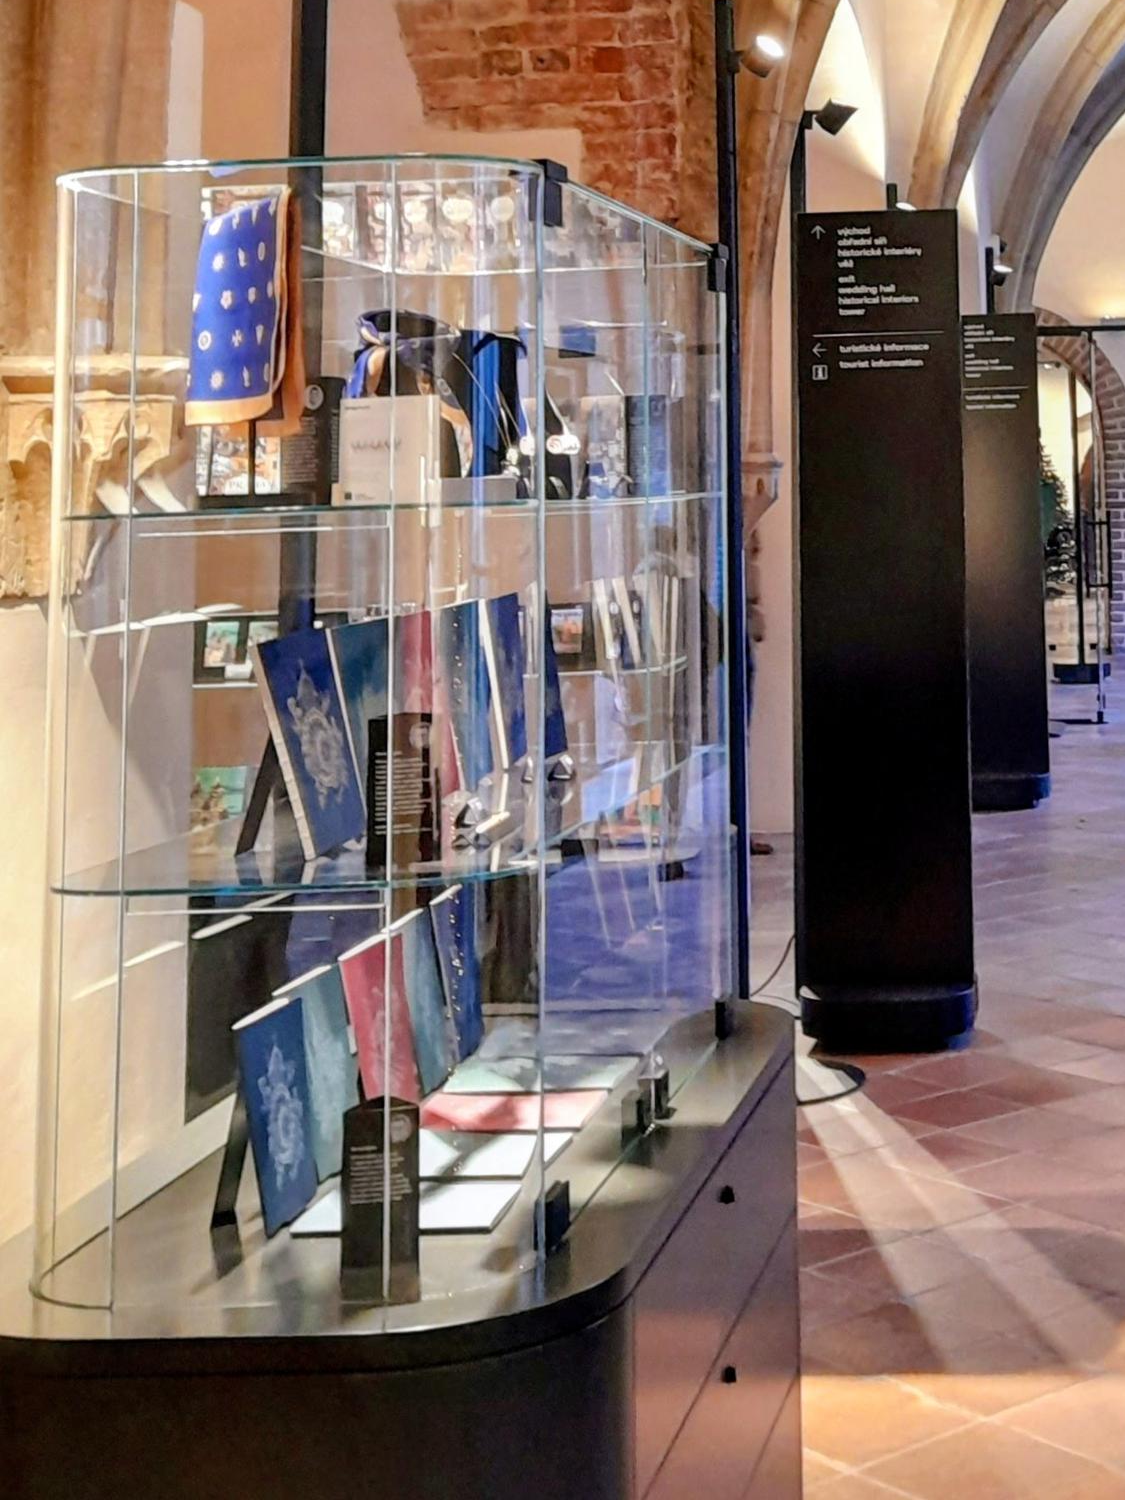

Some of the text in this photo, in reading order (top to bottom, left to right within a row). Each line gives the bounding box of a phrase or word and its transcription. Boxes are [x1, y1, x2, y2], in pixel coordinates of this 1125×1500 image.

[838, 275, 855, 283] exit
[838, 284, 896, 295] wedding hall
[838, 295, 919, 305] historical interiors
[839, 308, 865, 316] tower
[839, 344, 929, 353] turistické informace
[839, 359, 924, 368] tourist information
